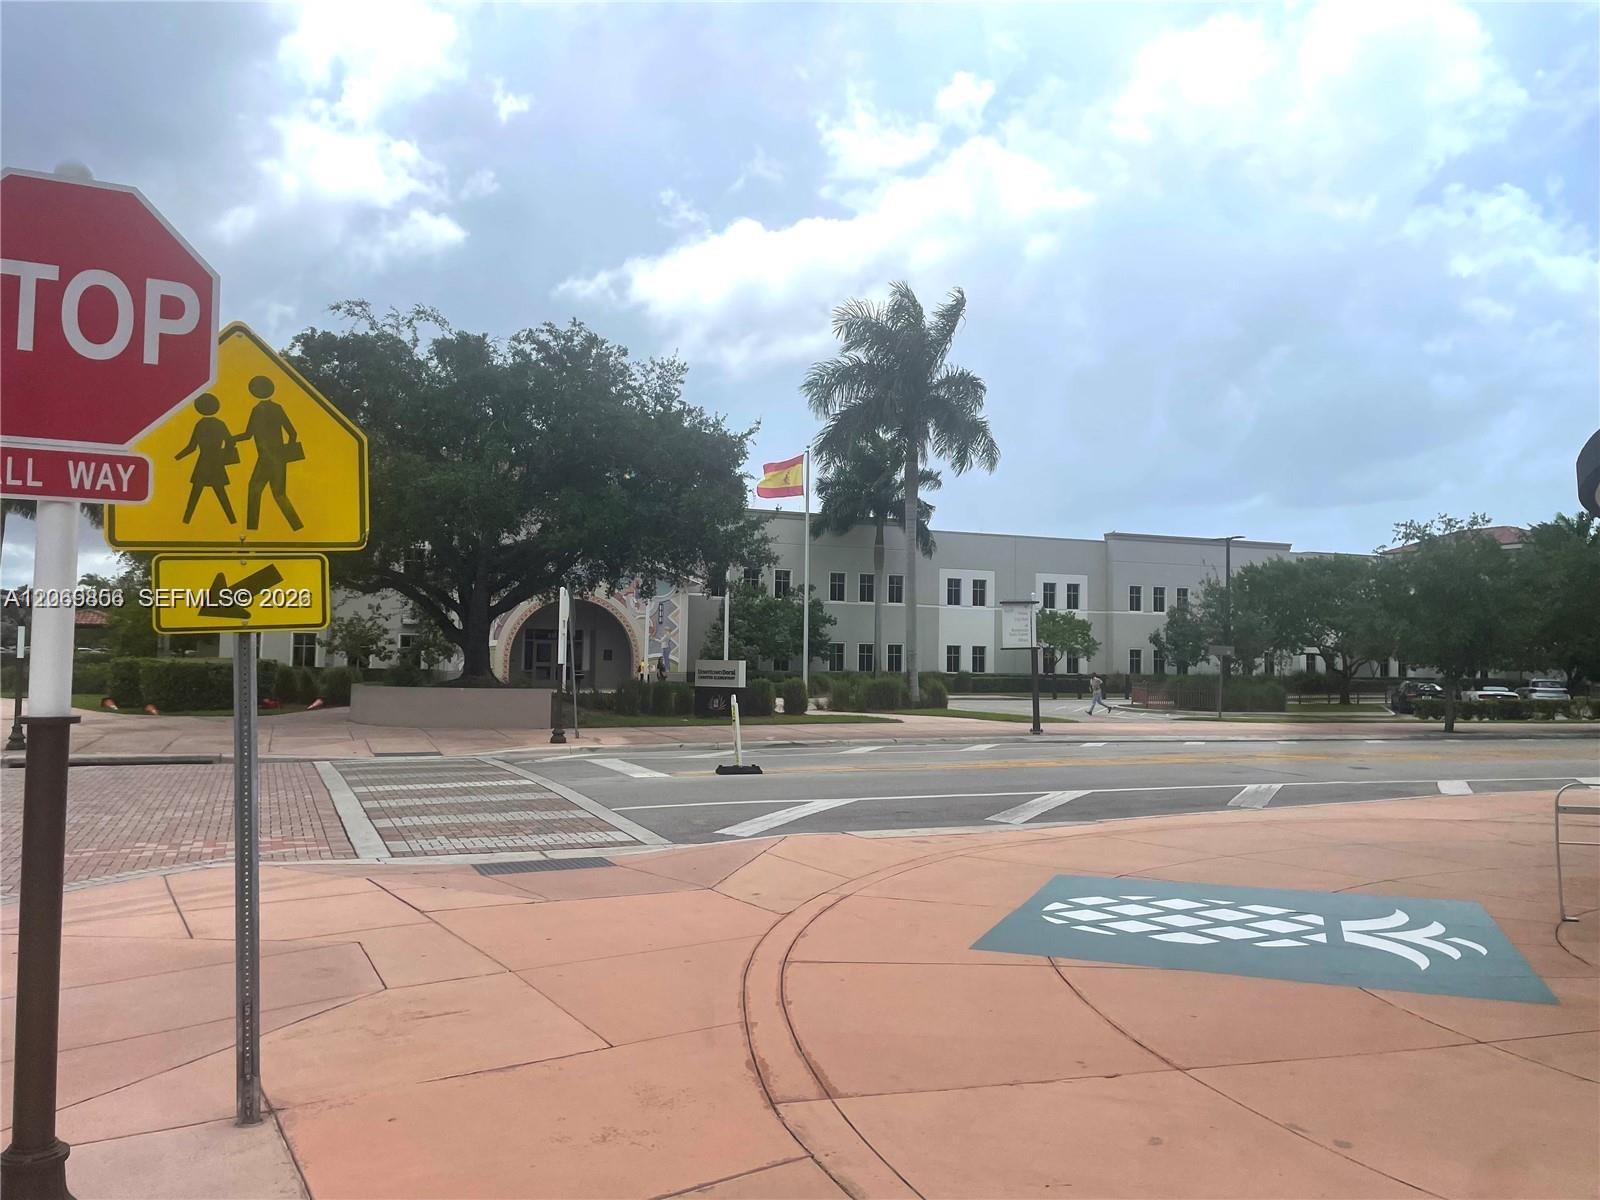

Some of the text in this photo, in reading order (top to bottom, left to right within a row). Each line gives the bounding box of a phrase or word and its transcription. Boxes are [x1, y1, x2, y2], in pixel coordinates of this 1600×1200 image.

[0, 258, 200, 365] TOP
[0, 456, 136, 492] LL WAY
